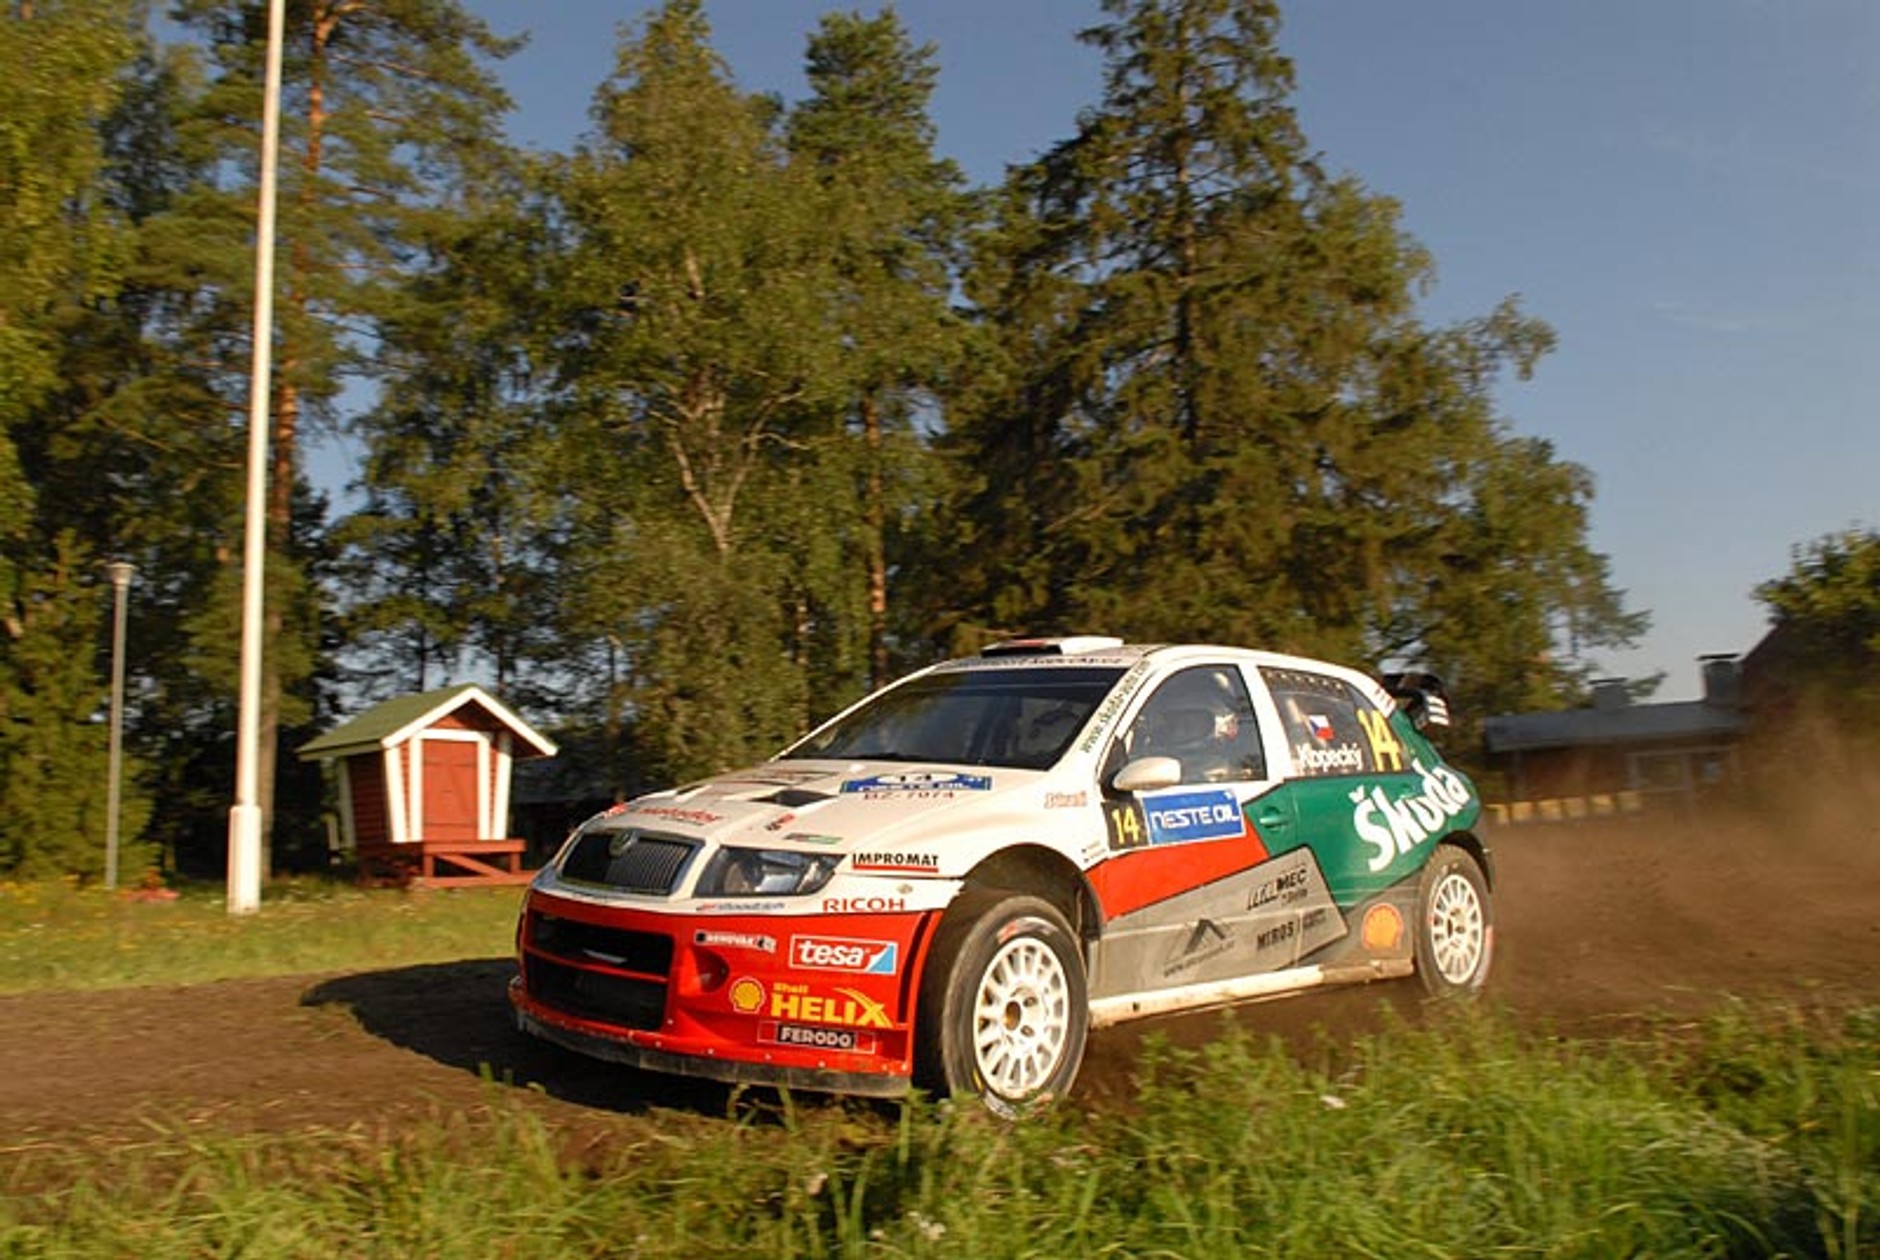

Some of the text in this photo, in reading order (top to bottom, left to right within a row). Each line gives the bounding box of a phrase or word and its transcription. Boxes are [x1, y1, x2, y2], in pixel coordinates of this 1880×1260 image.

[1356, 708, 1402, 772] 14
[1111, 806, 1141, 846] 14
[1151, 804, 1241, 830] NESTE OIL
[1348, 757, 1470, 873] Škoda
[853, 853, 939, 867] IMPROMAT
[822, 898, 906, 912] RICOH
[798, 940, 864, 966] tesa
[773, 982, 809, 995] Shell
[770, 987, 894, 1029] HELIX
[780, 1027, 852, 1048] FERODO
